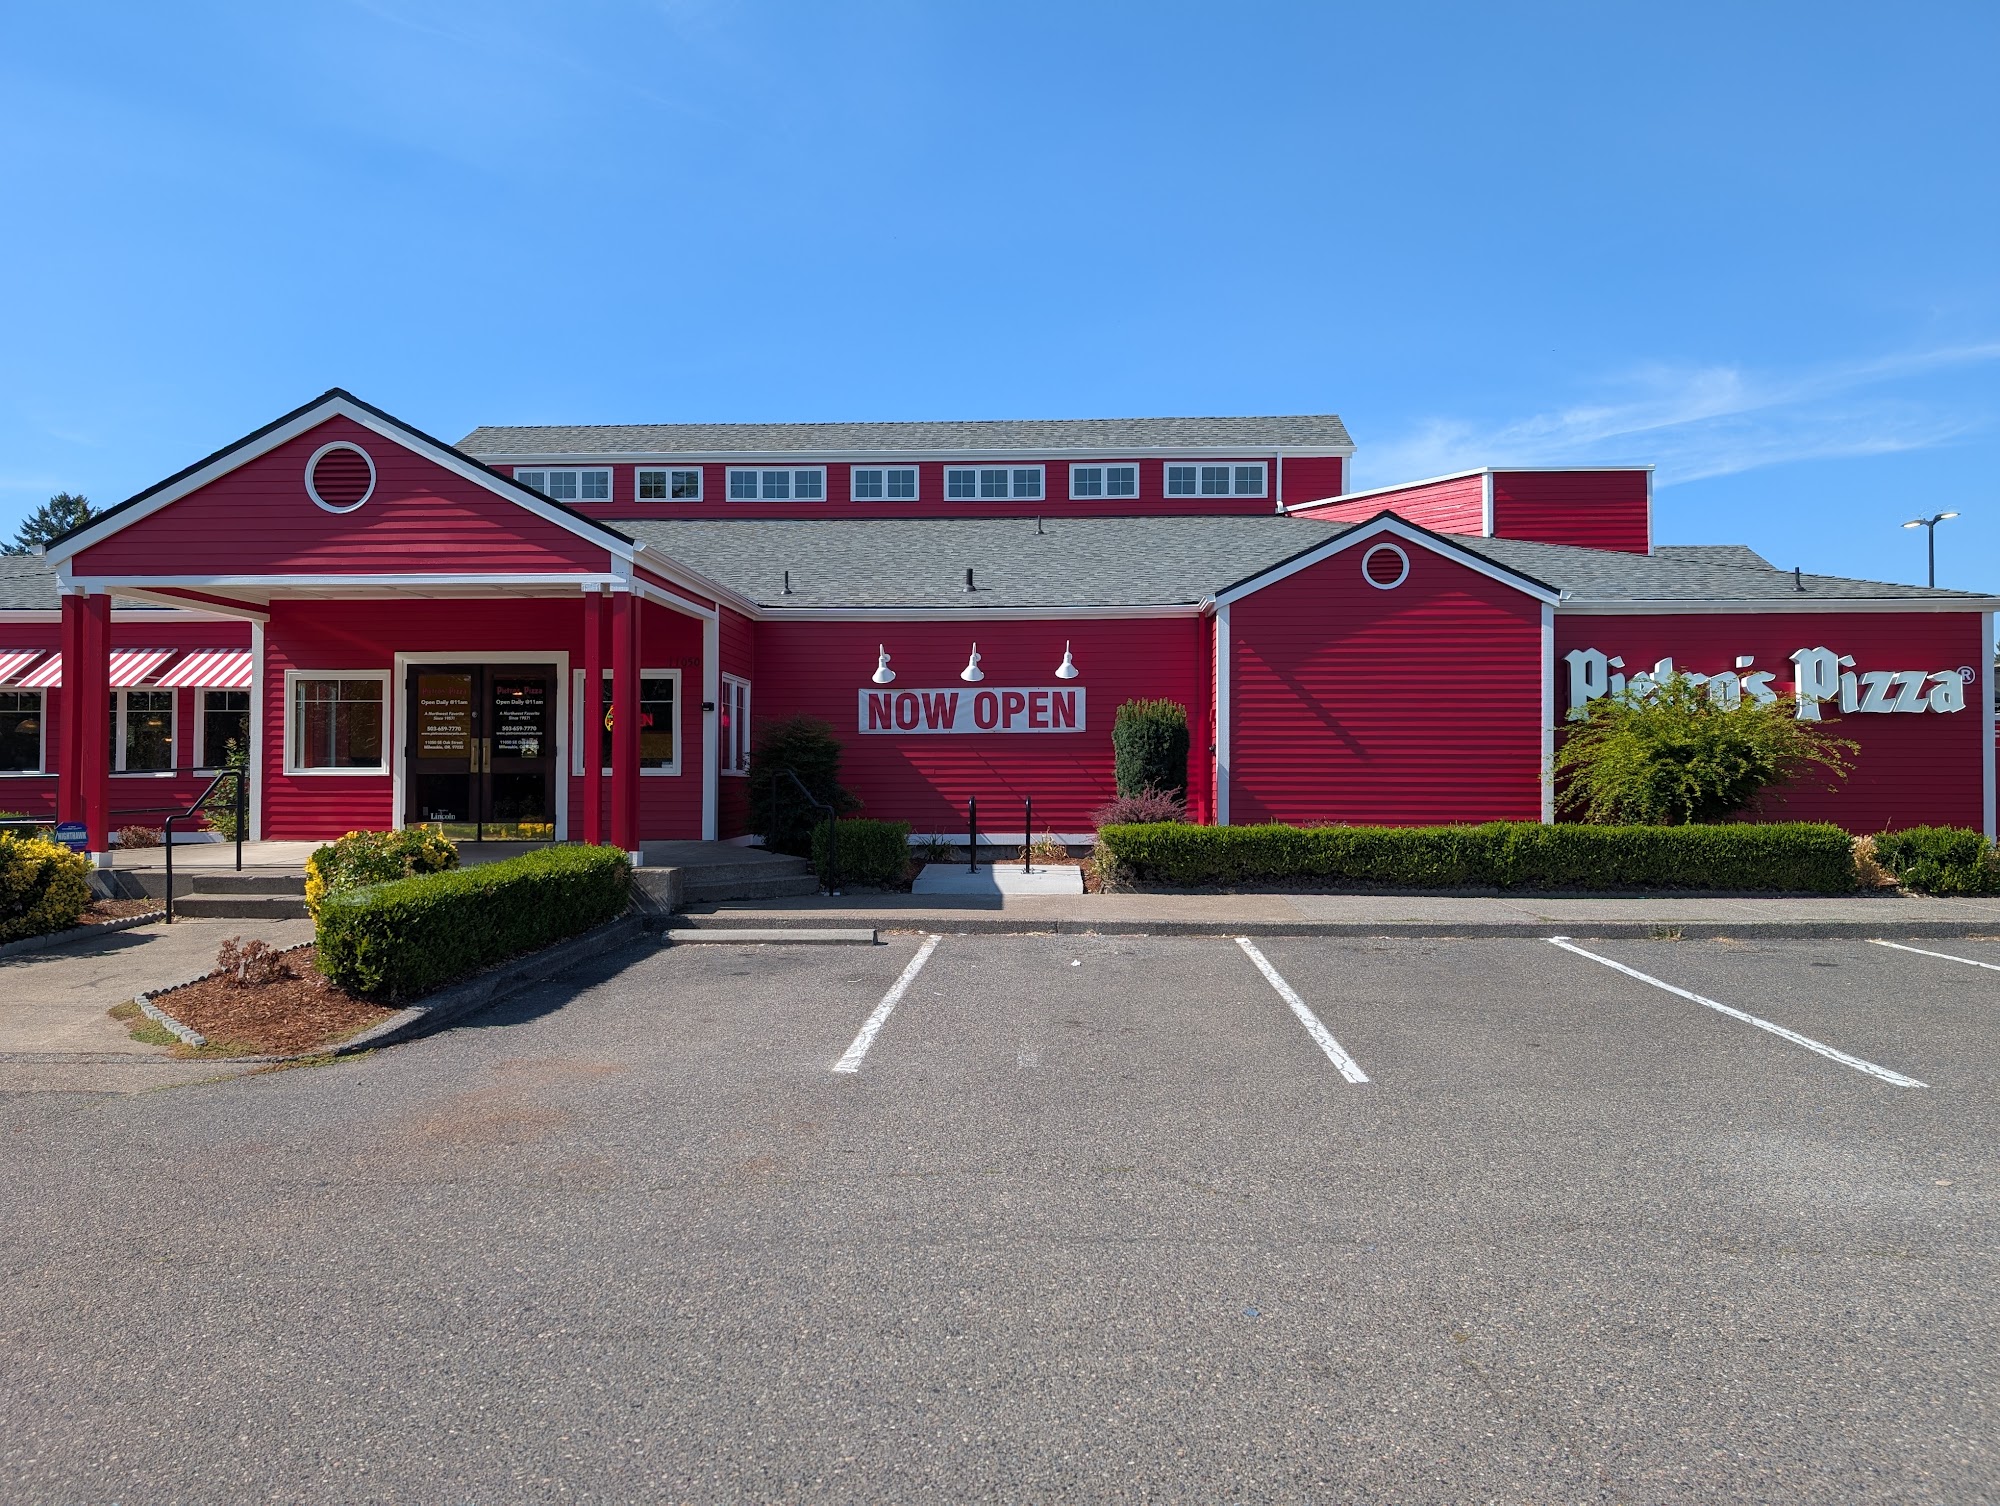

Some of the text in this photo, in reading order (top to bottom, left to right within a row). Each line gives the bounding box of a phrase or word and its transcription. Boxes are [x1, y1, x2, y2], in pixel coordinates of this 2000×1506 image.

[669, 656, 700, 667] 11050
[436, 699, 449, 707] Daily
[867, 691, 1076, 731] NOW OPEN
